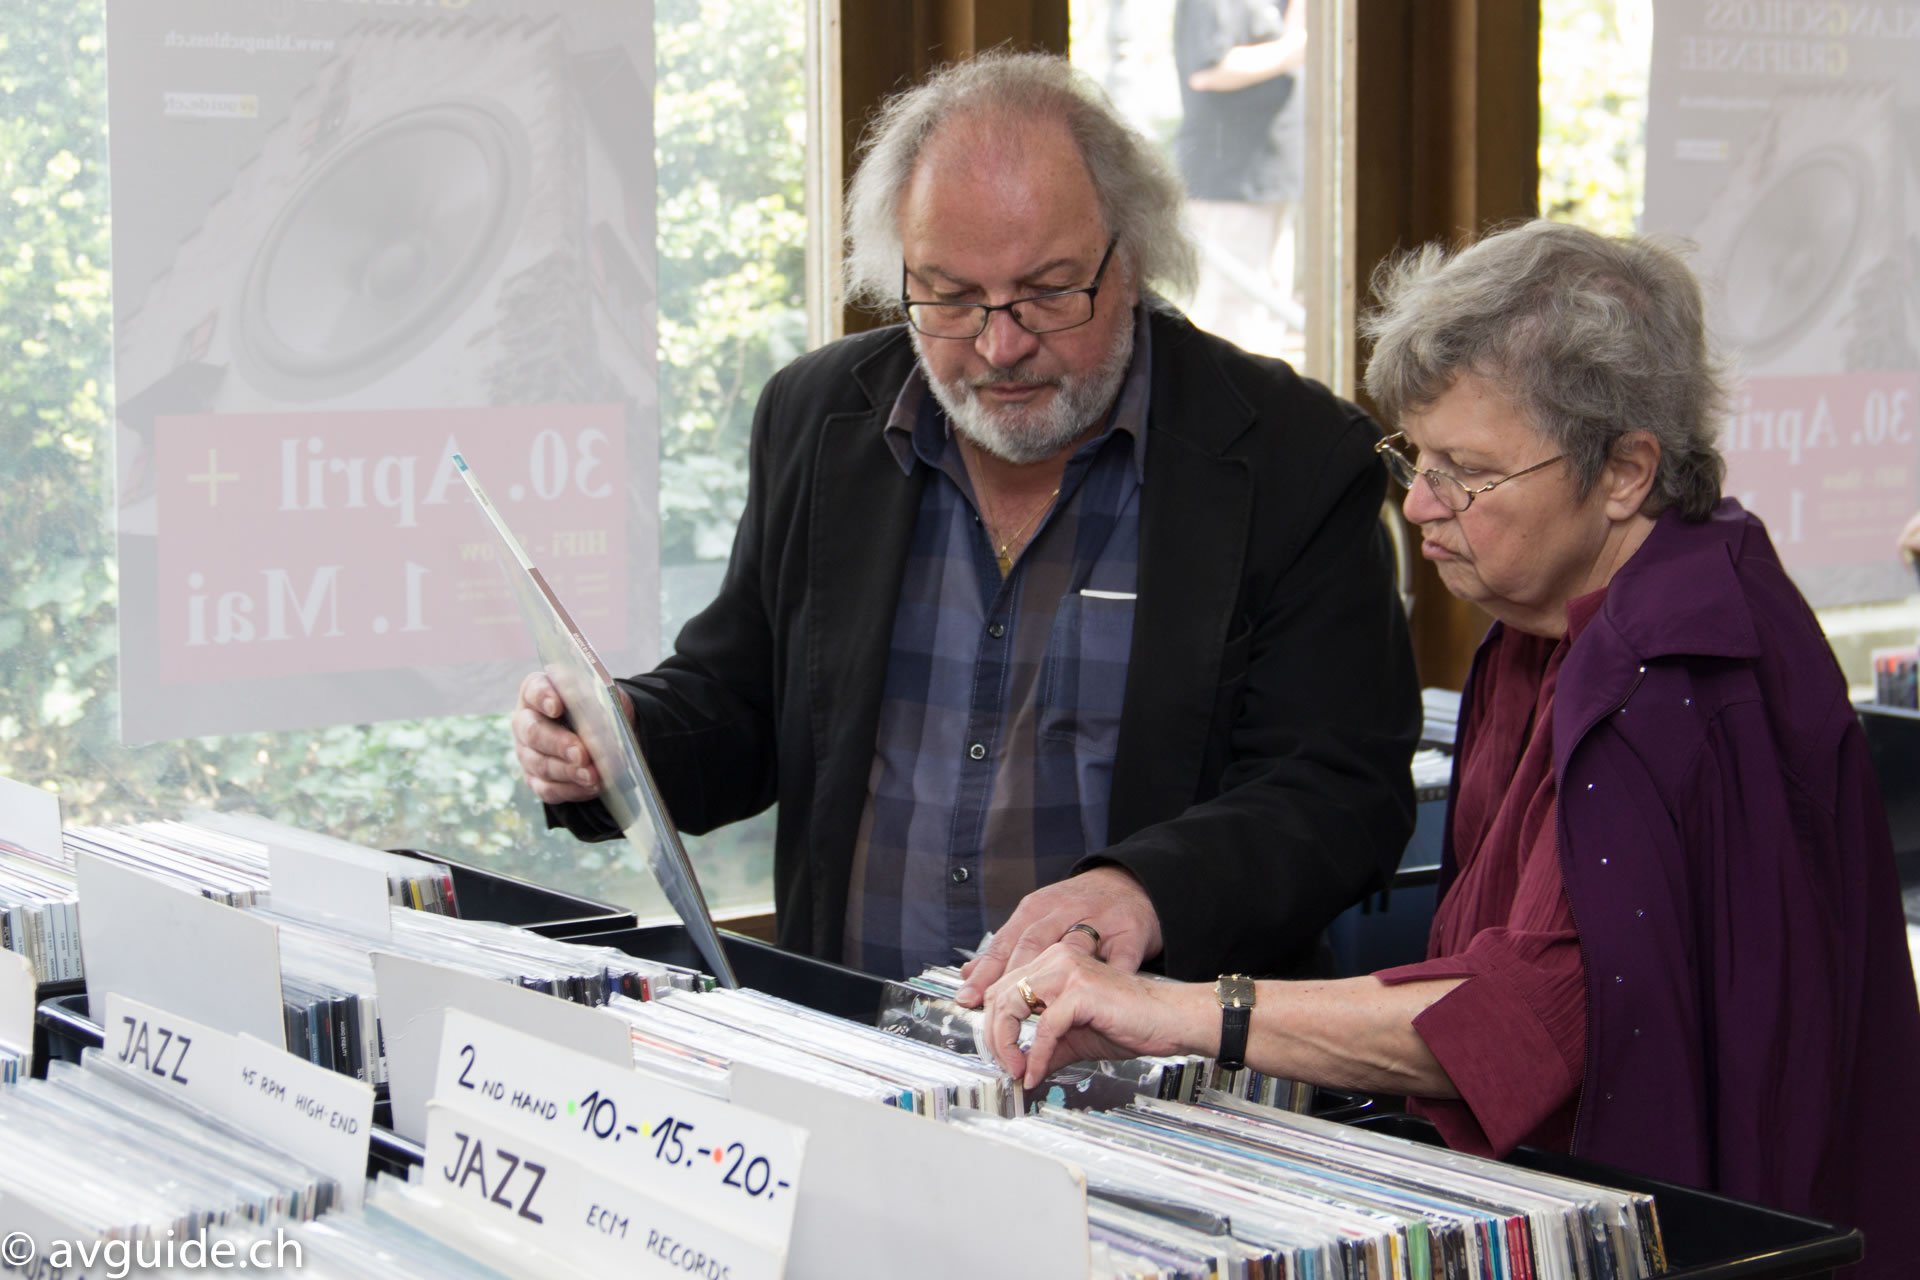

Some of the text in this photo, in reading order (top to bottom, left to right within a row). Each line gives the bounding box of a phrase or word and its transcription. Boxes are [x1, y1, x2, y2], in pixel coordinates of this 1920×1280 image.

[117, 1016, 192, 1085] JAZZ
[241, 1066, 258, 1086] 45
[260, 1076, 286, 1101] RPM
[511, 1090, 558, 1121] HAND
[444, 1132, 732, 1280] JAZZ ECM RECORDS
